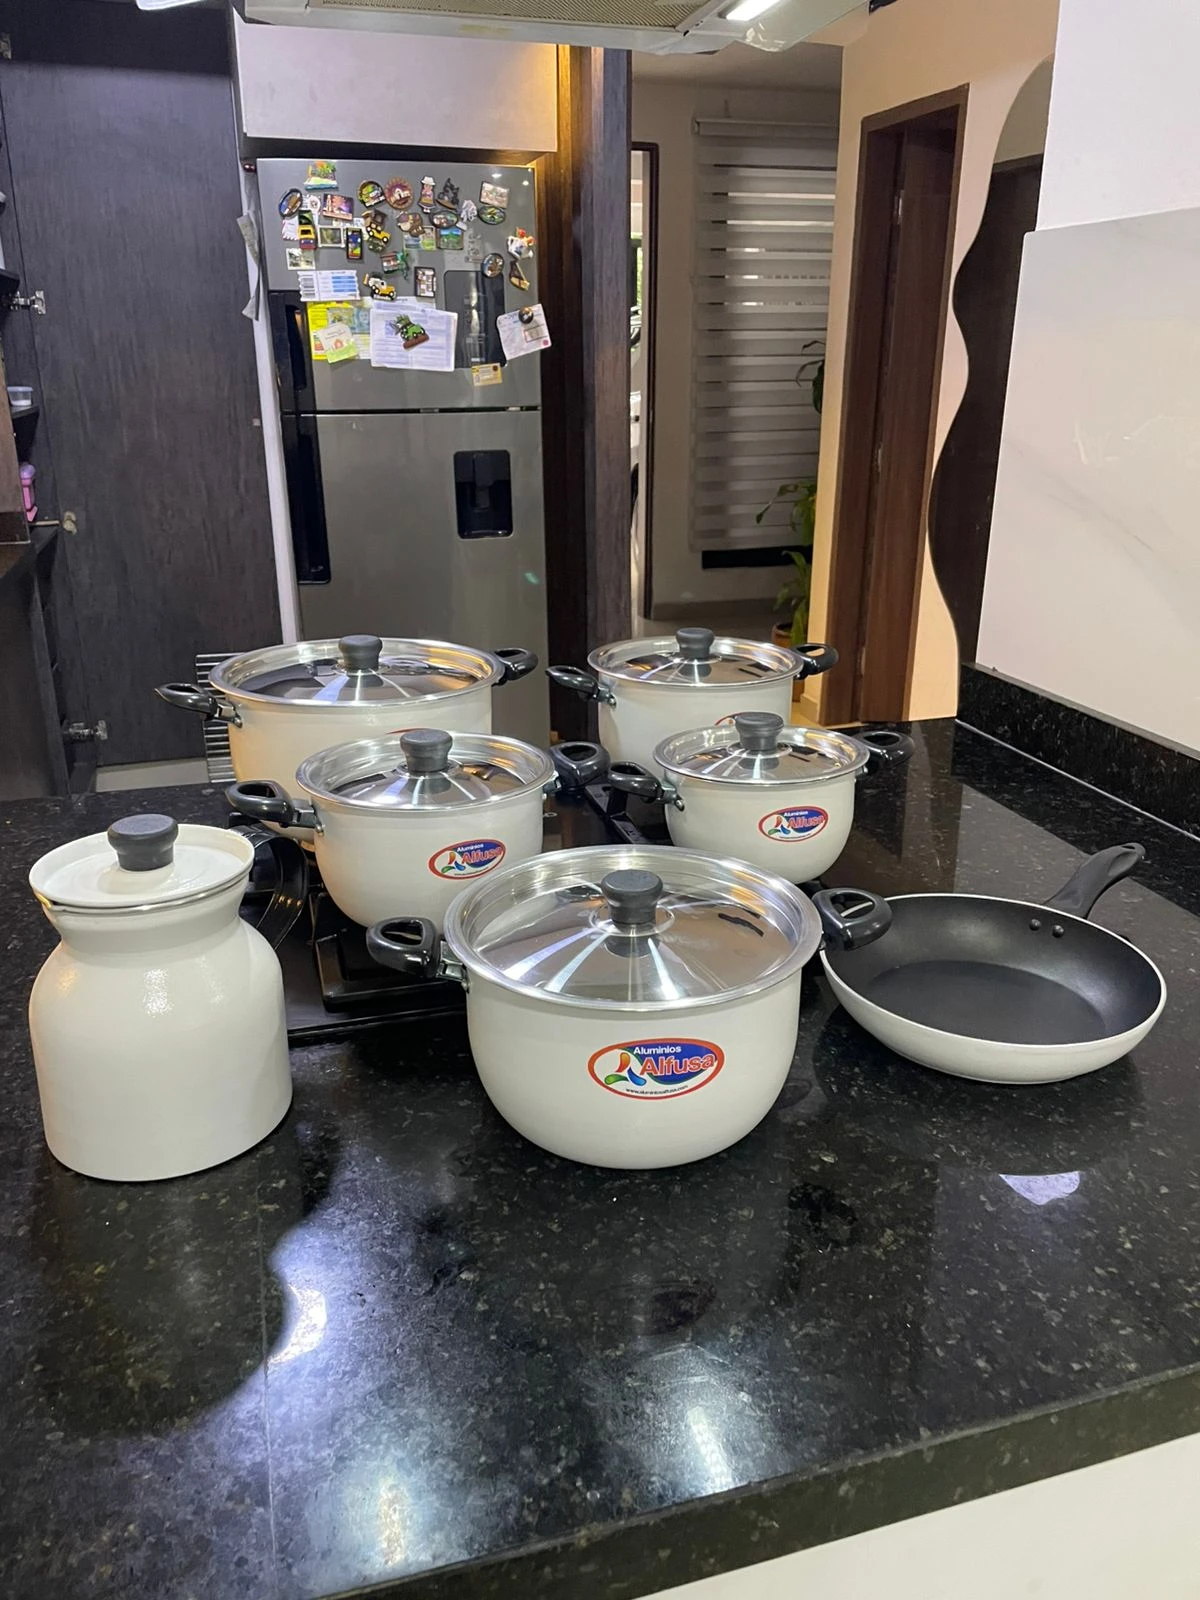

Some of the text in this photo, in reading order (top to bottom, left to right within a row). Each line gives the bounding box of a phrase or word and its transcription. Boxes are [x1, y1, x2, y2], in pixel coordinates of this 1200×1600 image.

[787, 815, 824, 828] Alfusa
[461, 847, 503, 864] Alfusa
[633, 1046, 682, 1056] Aluminios
[639, 1054, 716, 1076] Alfusa
